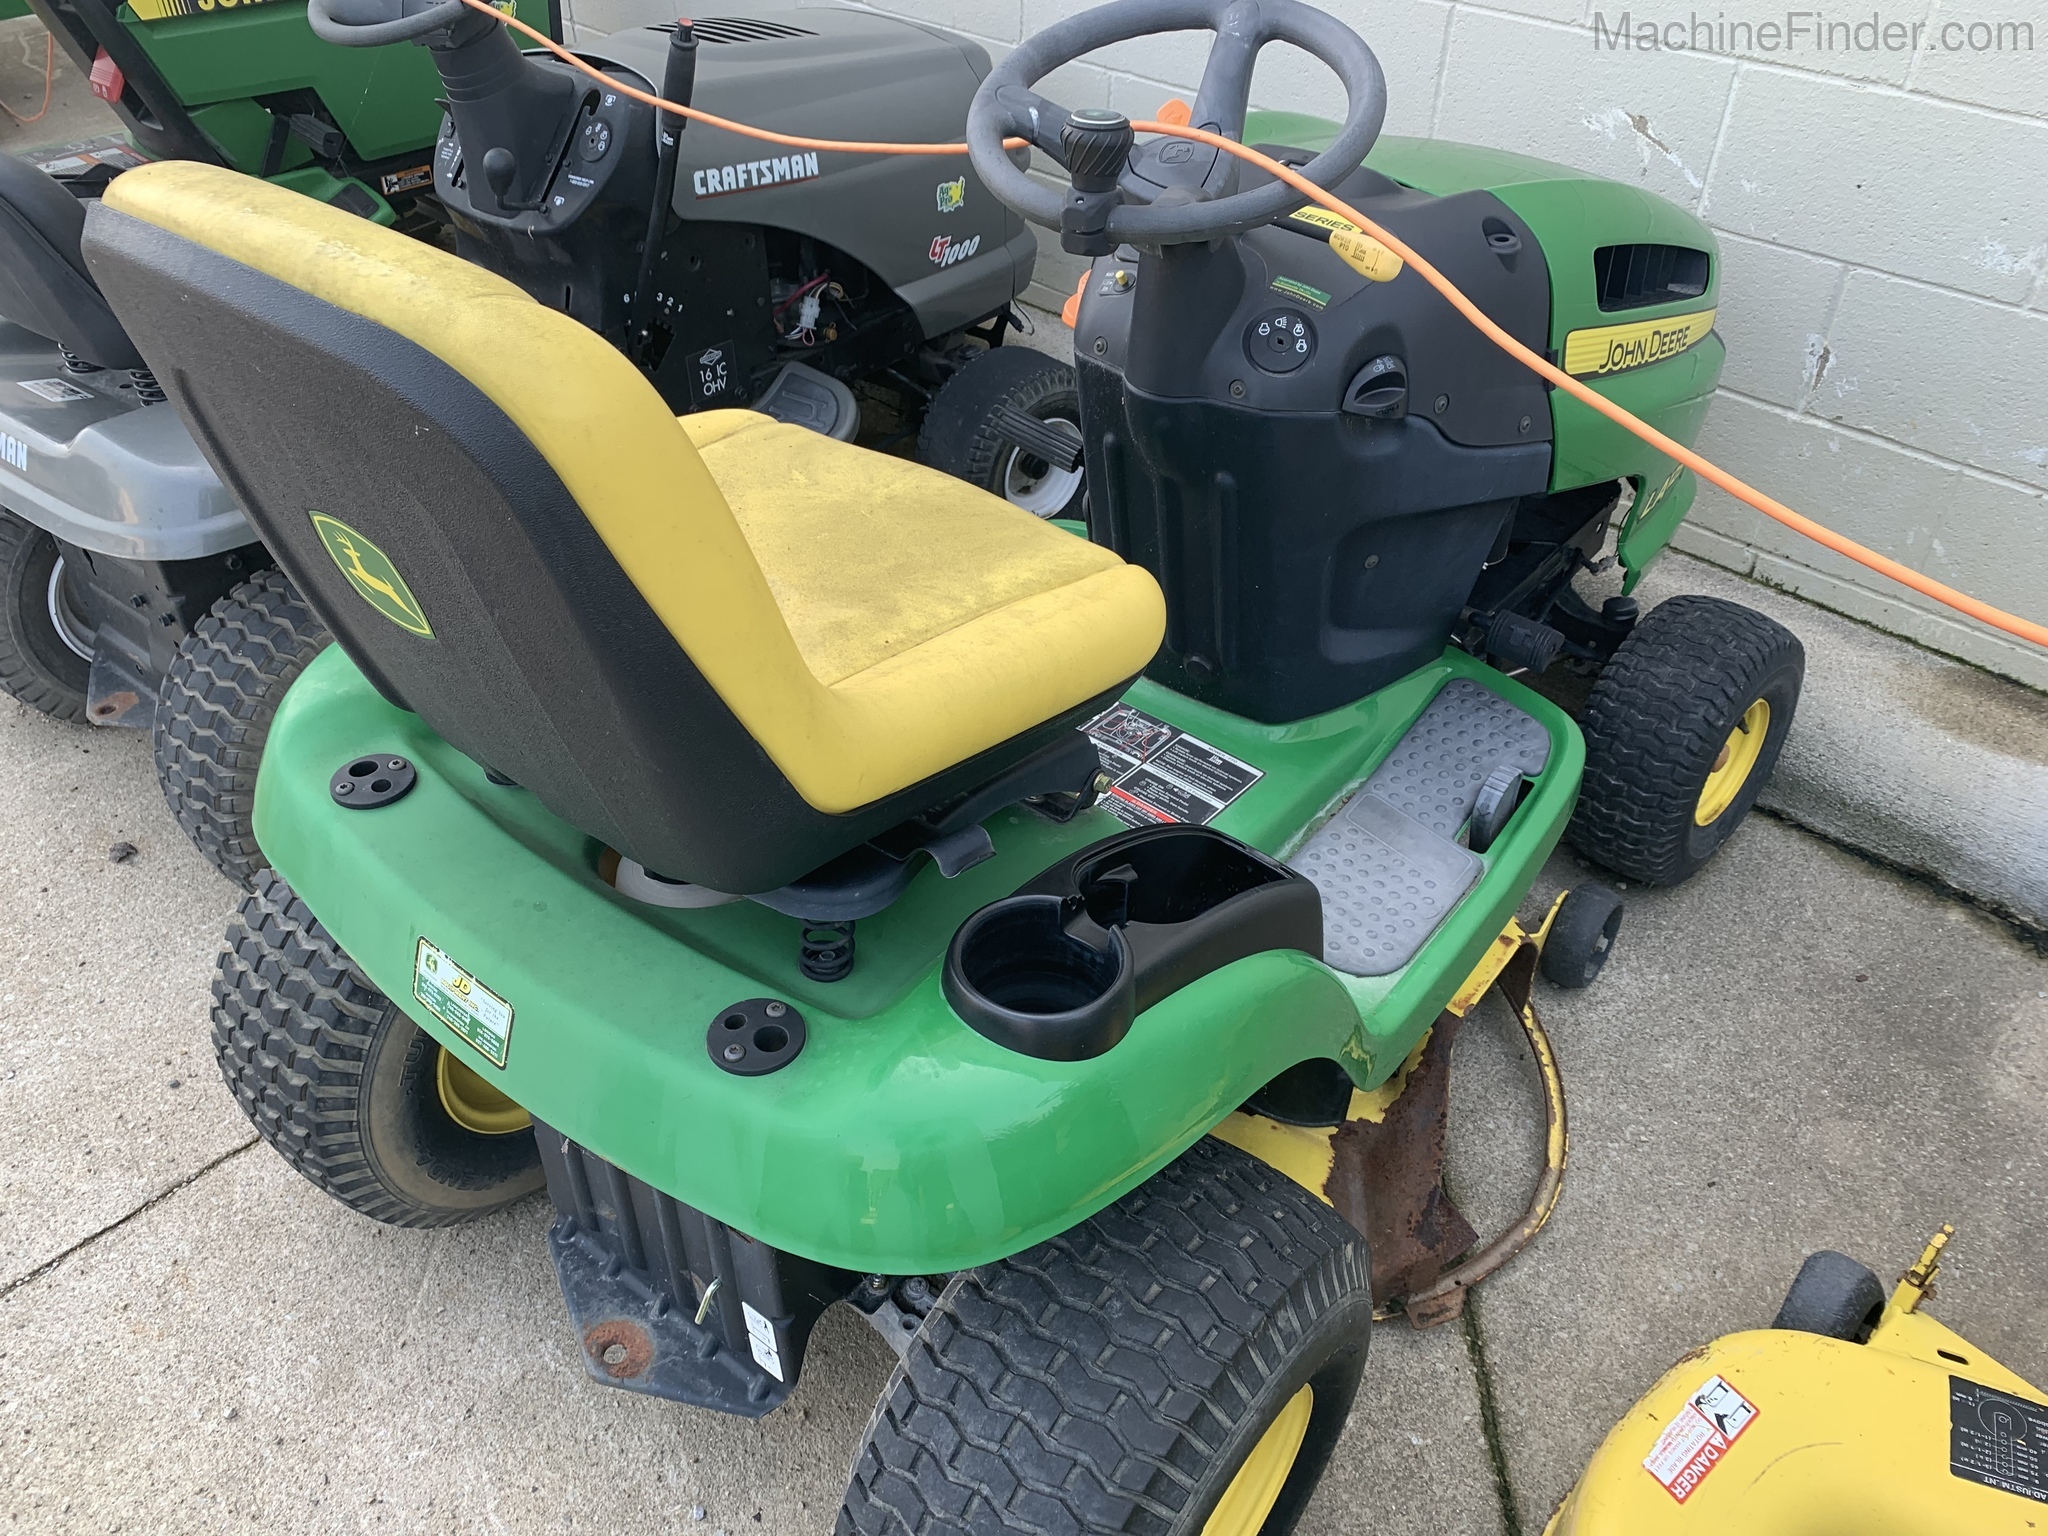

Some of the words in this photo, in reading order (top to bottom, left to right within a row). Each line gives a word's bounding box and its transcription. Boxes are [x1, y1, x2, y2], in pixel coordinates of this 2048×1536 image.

[693, 151, 819, 196] CRAFTSMAN
[1294, 211, 1355, 232] SERIES
[624, 293, 630, 303] 6
[656, 292, 663, 302] 3
[667, 297, 674, 307] 2
[1599, 337, 1648, 370] JOHN
[1650, 325, 1691, 357] DEERE
[700, 368, 712, 383] 16
[703, 376, 727, 396] OHV
[452, 975, 471, 996] JD
[1670, 1444, 1719, 1499] DANGER
